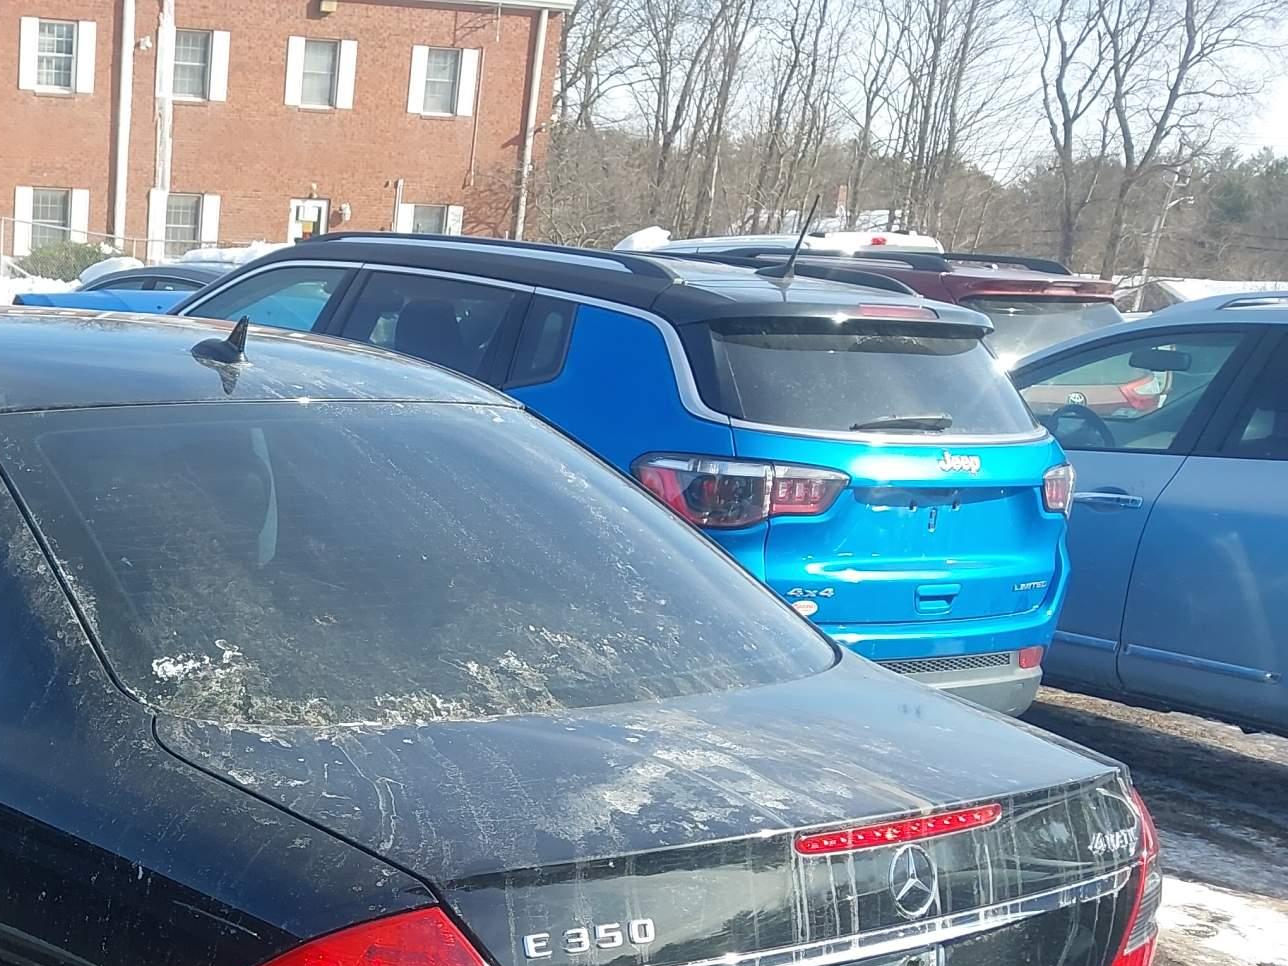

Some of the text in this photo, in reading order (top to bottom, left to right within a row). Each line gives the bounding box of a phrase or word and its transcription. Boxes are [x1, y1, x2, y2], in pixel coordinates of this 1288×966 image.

[936, 449, 981, 475] Jeep
[786, 587, 835, 598] 4x4
[524, 918, 656, 959] E 350
